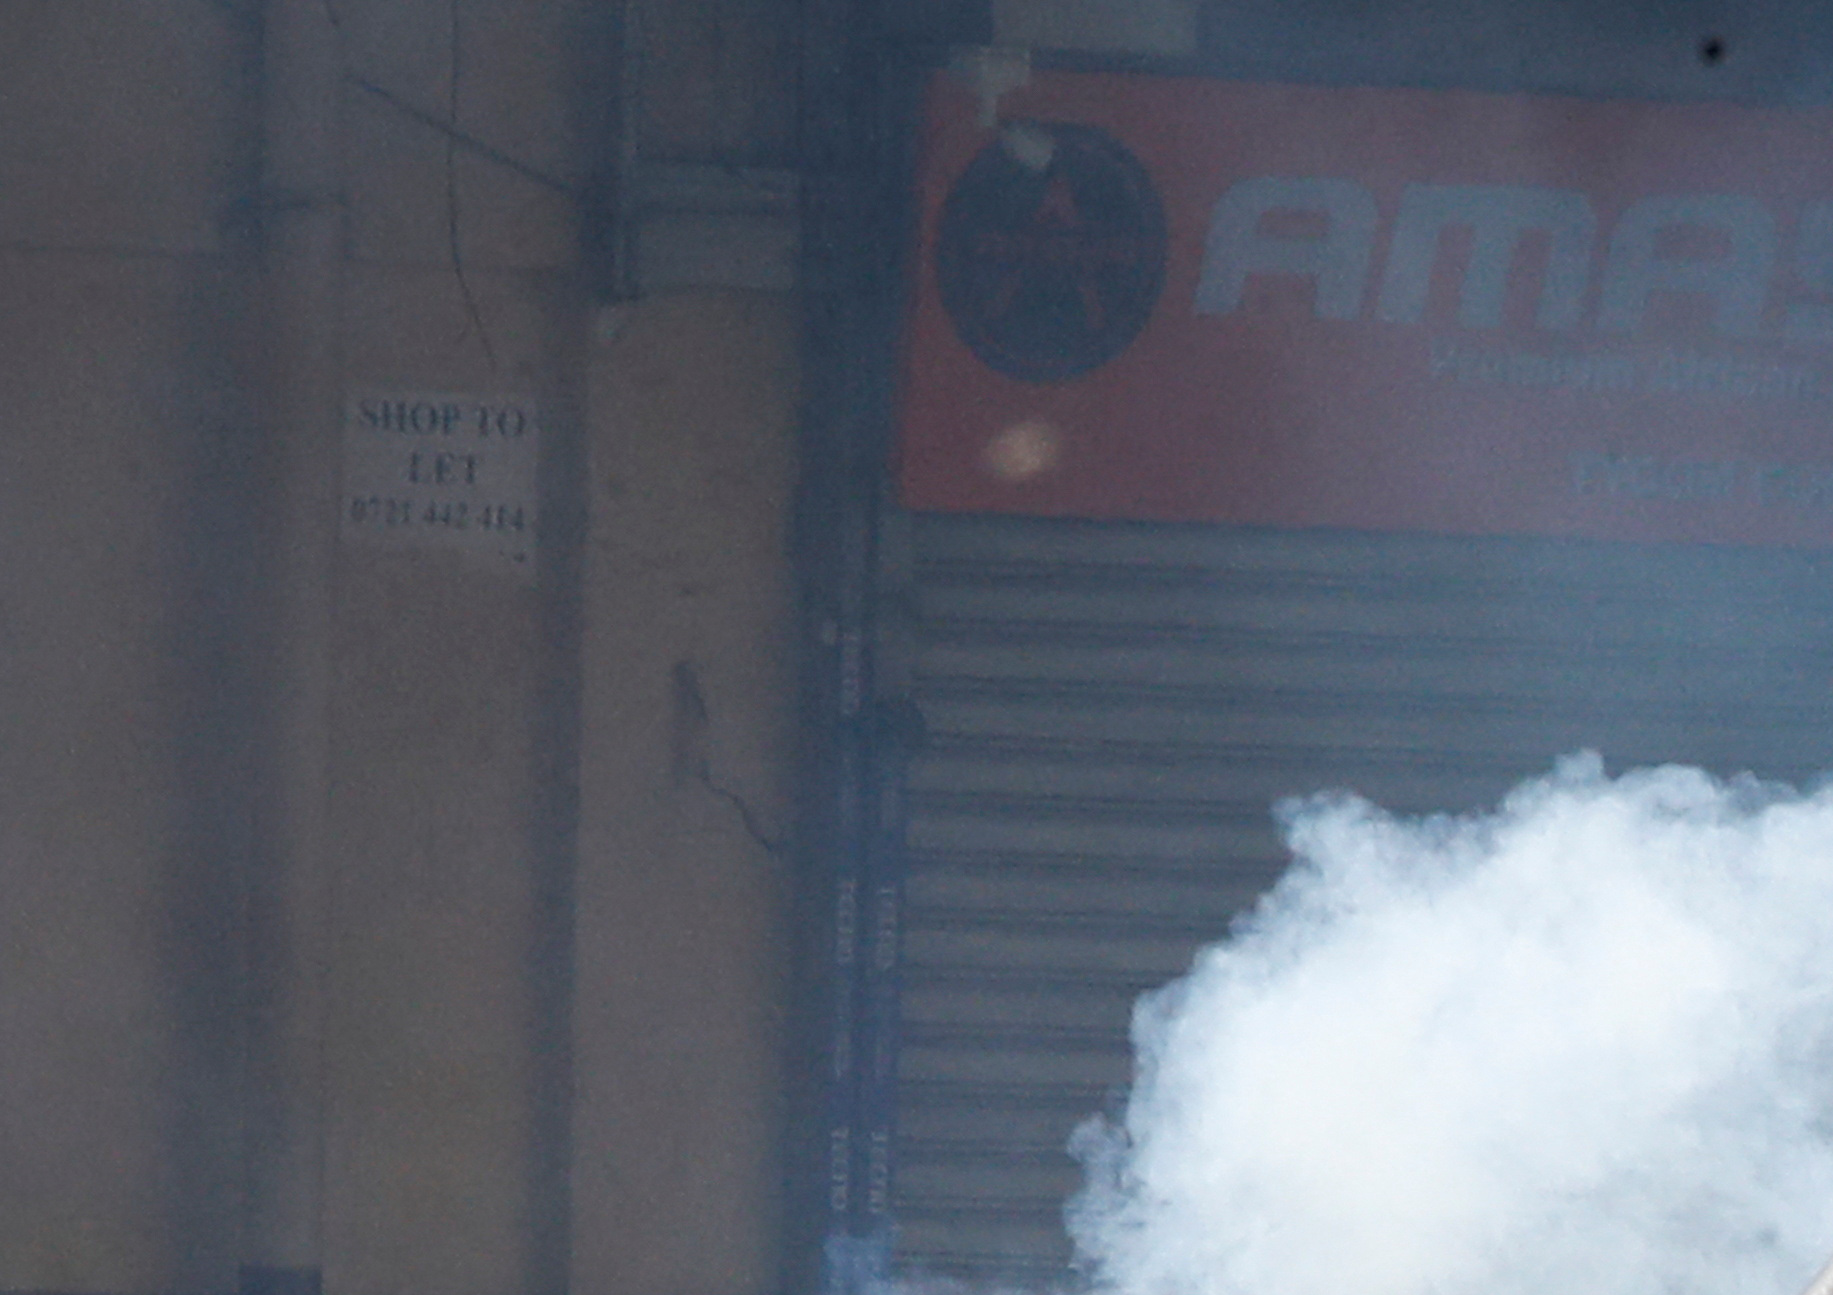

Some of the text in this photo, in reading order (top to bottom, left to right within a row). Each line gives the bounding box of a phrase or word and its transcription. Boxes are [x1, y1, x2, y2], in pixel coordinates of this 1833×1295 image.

[360, 400, 525, 437] SHOP TO
[409, 452, 477, 485] LET
